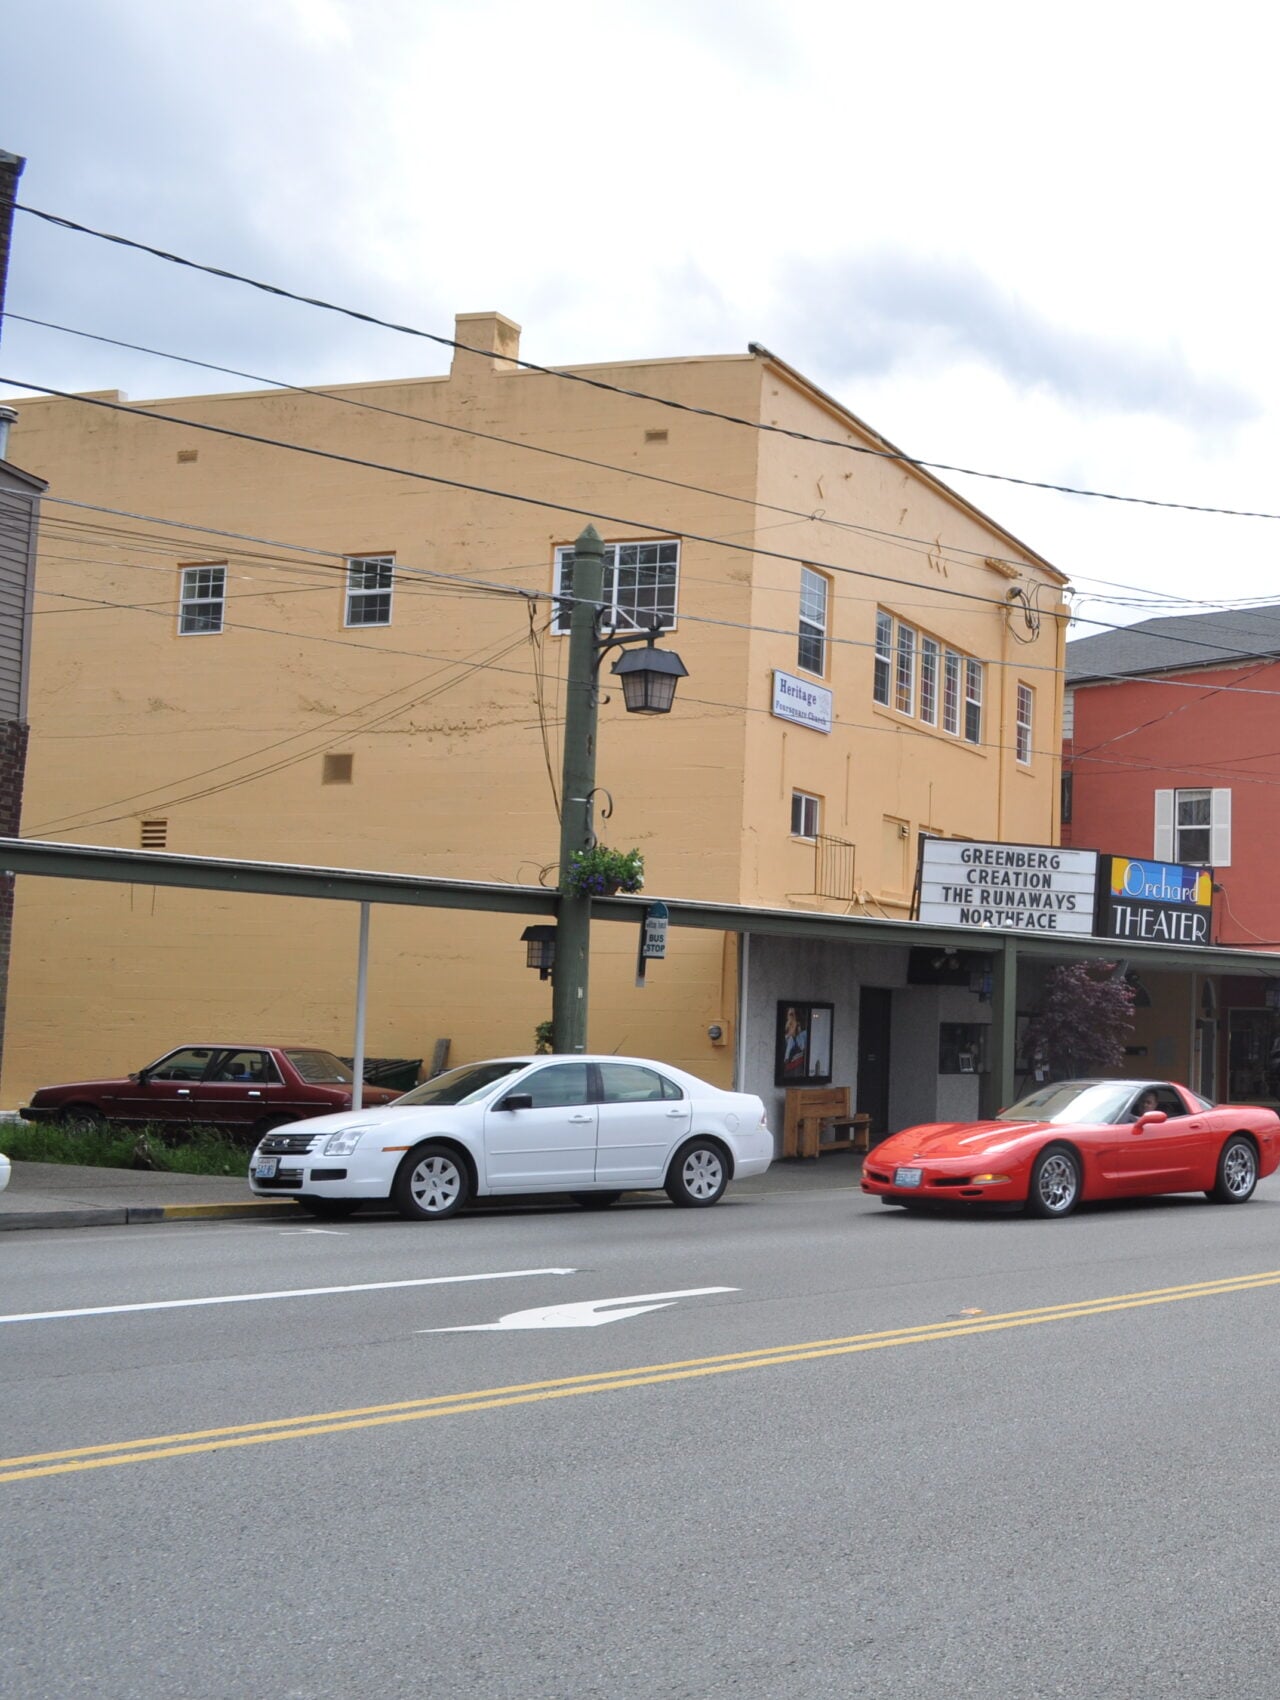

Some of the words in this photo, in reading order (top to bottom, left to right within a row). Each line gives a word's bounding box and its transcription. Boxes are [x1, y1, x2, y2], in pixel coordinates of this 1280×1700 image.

[780, 678, 817, 707] Heritage
[960, 847, 1061, 870] GREENBERG
[966, 868, 1052, 889] CREATION
[1123, 861, 1200, 902] Orchard
[942, 886, 974, 904] THE
[980, 889, 1076, 911] RUNAWAYS
[959, 907, 1057, 929] NORTHFACE
[1112, 904, 1206, 943] THEATER
[646, 943, 666, 953] STOP
[649, 934, 665, 943] BUS
